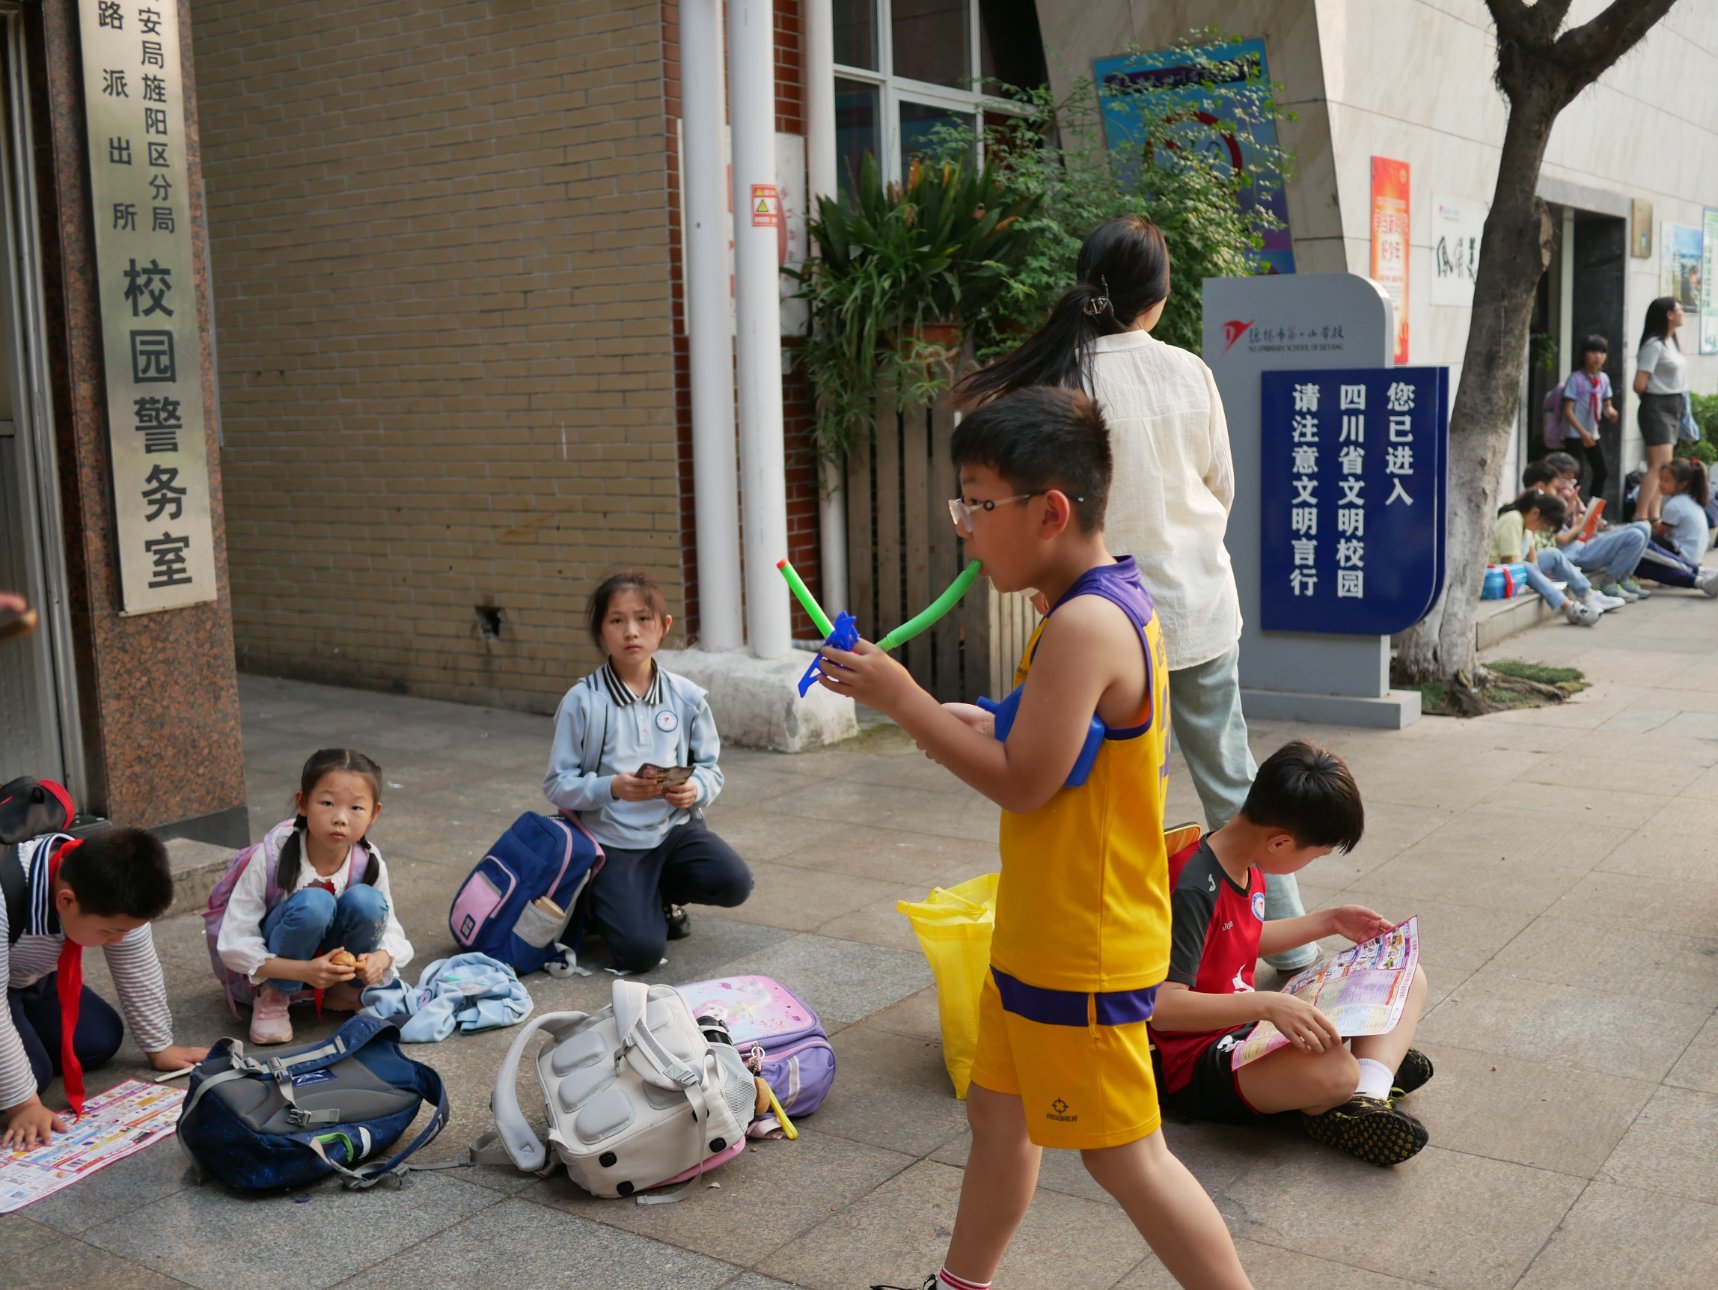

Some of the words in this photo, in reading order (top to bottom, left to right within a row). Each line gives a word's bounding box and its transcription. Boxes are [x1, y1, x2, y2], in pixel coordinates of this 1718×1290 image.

[138, 0, 176, 235] 安局旌阳区分局
[124, 258, 193, 590] 校园警务室
[1290, 383, 1320, 597] 请注意文明言行
[1336, 384, 1367, 599] 四川省文明校园
[1385, 382, 1416, 506] 您已进入
